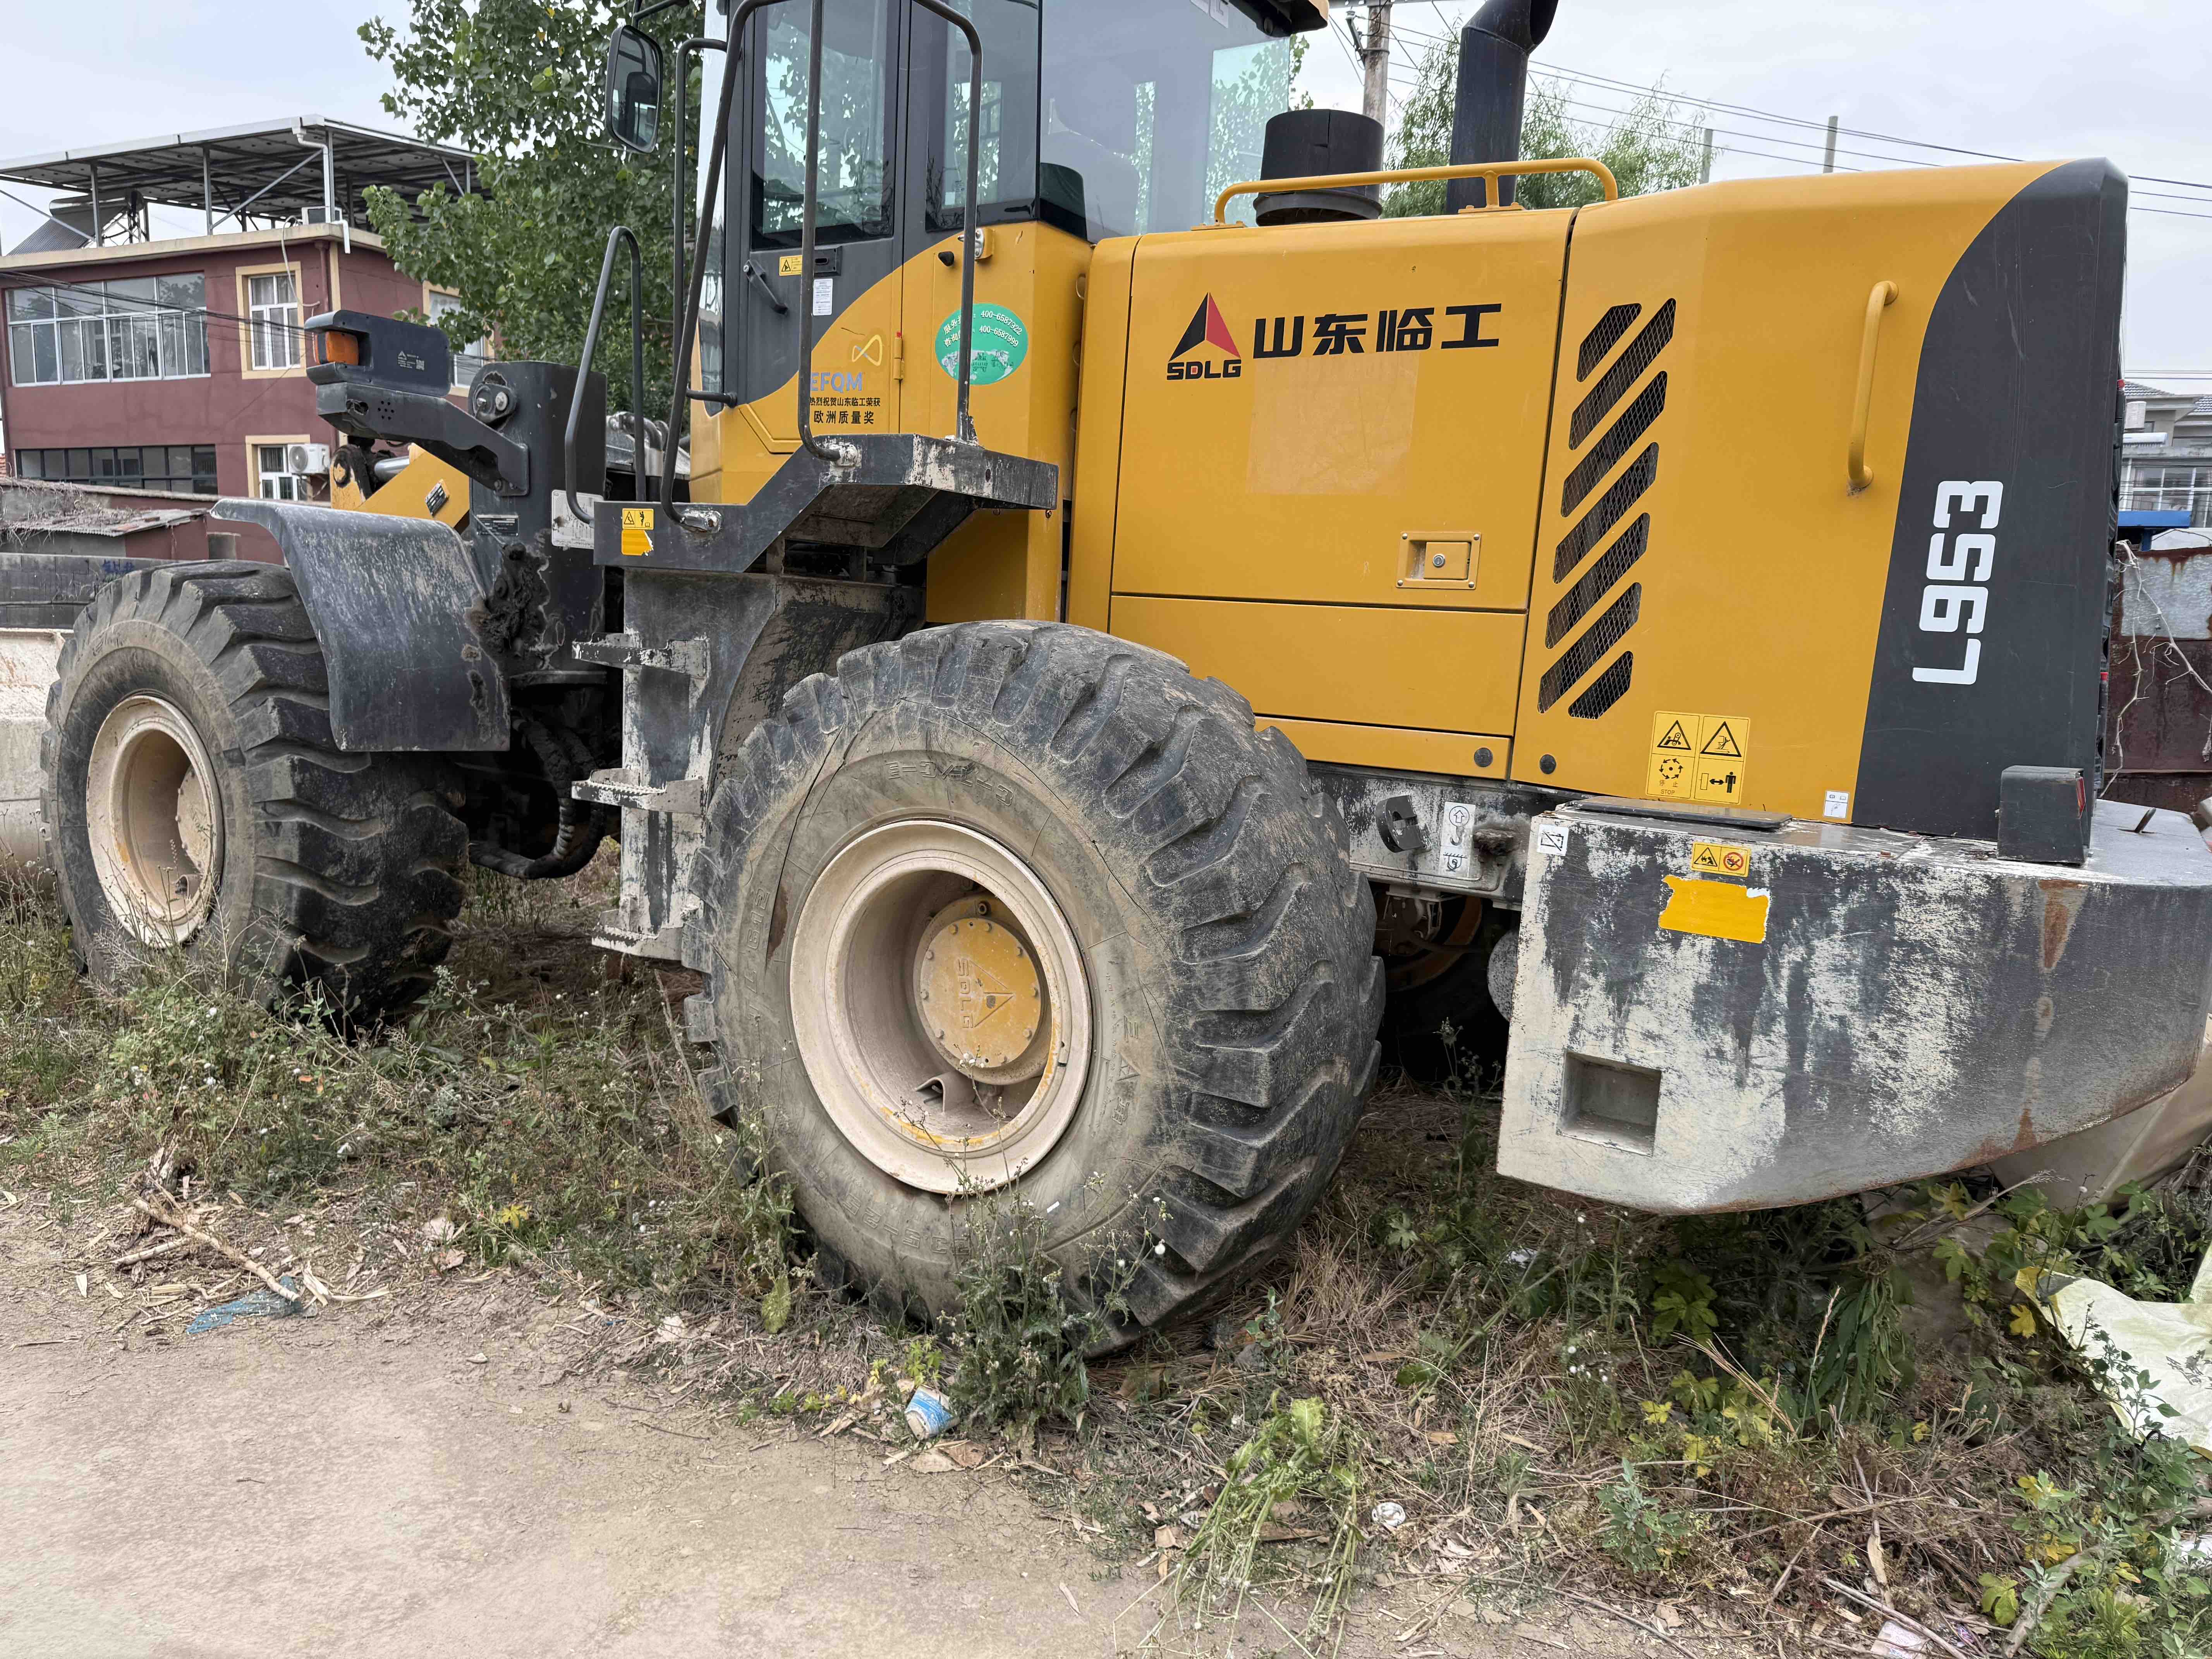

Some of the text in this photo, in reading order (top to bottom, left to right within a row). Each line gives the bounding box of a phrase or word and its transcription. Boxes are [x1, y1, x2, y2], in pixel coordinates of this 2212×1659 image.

[979, 325, 1018, 347] 400-6587999
[1253, 303, 1501, 359] 山东临工
[1167, 359, 1242, 380] SDLG
[811, 372, 862, 393] EFQM
[814, 410, 874, 424] 欧洲质量奖
[1912, 481, 2003, 685] L953
[957, 958, 974, 1029] SDLG
